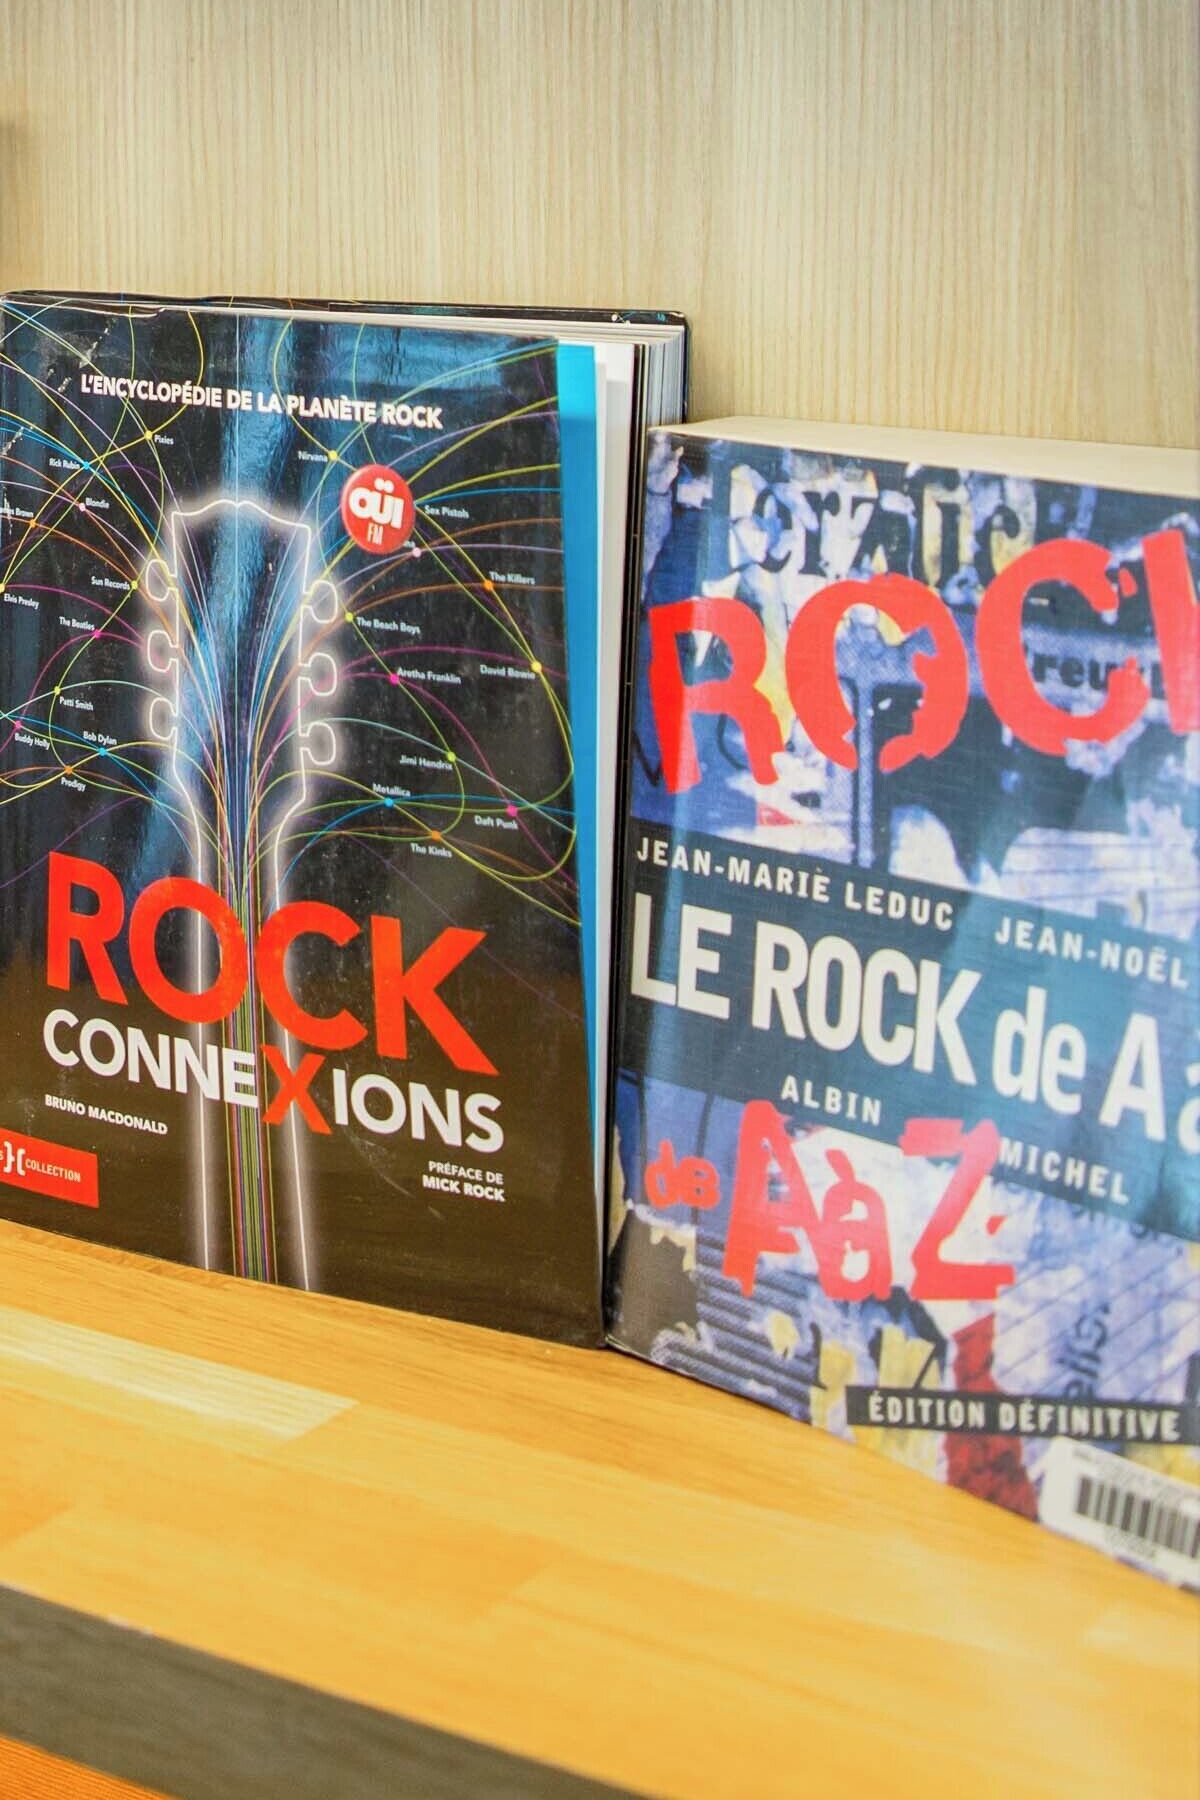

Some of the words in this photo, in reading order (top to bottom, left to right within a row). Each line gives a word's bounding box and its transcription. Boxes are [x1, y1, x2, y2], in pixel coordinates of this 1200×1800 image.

[80, 373, 223, 408] L'ENCYCLOPÉDIE
[226, 389, 253, 411] DE
[257, 390, 283, 414] LA
[286, 394, 378, 423] PLANÈTE
[381, 402, 444, 429] ROCK
[154, 434, 175, 446] Pixies
[49, 457, 62, 468] Rick
[63, 459, 81, 470] Rubin
[298, 451, 328, 462] Nirvana
[85, 497, 110, 510] Blondie
[424, 504, 441, 516] Sex
[442, 506, 470, 519] Pistols
[15, 507, 34, 518] Brown
[367, 522, 384, 545] FM
[91, 575, 103, 586] Sun
[104, 578, 130, 590] Records
[489, 570, 506, 582] The
[507, 572, 536, 585] Killers
[4, 593, 18, 603] Elvis
[18, 596, 39, 610] Presley
[59, 616, 70, 627] The
[71, 618, 95, 631] Beatles
[356, 616, 372, 628] The
[373, 618, 399, 631] Beach
[400, 622, 421, 635] Boys
[397, 667, 426, 680] Aretha
[427, 670, 461, 684] Franklin
[480, 664, 506, 676] David
[507, 667, 536, 680] Bowie
[59, 696, 74, 707] Patti
[75, 699, 94, 711] Smith
[14, 732, 33, 747] Buddy
[34, 736, 50, 750] Holly
[83, 730, 96, 741] Bob
[97, 732, 117, 746] Dylan
[400, 755, 418, 766] Jimi
[419, 756, 453, 771] Hendrix
[60, 777, 86, 792] Prodigy
[372, 783, 411, 797] Metallica
[474, 815, 494, 827] Daft
[496, 817, 518, 830] Punk
[411, 842, 426, 855] The
[428, 845, 452, 858] Kinks
[845, 881, 955, 932] LEDUC
[994, 916, 1190, 991] JEAN-NOËL
[47, 851, 499, 1077] ROCK
[631, 892, 733, 1021] LE
[752, 919, 983, 1087] ROCK
[992, 984, 1088, 1116] de
[1099, 1011, 1166, 1143] A
[43, 1008, 505, 1154] CONNEXIONS
[44, 1093, 86, 1115] BRUNO
[88, 1105, 169, 1136] MACDONALD
[780, 1074, 882, 1126] ALBIN
[1000, 1135, 1130, 1206] MICHEL
[25, 1158, 81, 1183] COLLECTION
[428, 1160, 483, 1182] PRÉFACE
[485, 1171, 505, 1186] DE
[422, 1174, 461, 1194] MICK
[463, 1182, 506, 1203] ROCK
[645, 1140, 721, 1210] de
[900, 1118, 1016, 1301] Z
[867, 1390, 986, 1429] ÉDITION
[999, 1397, 1182, 1443] DÉFINITIVE
